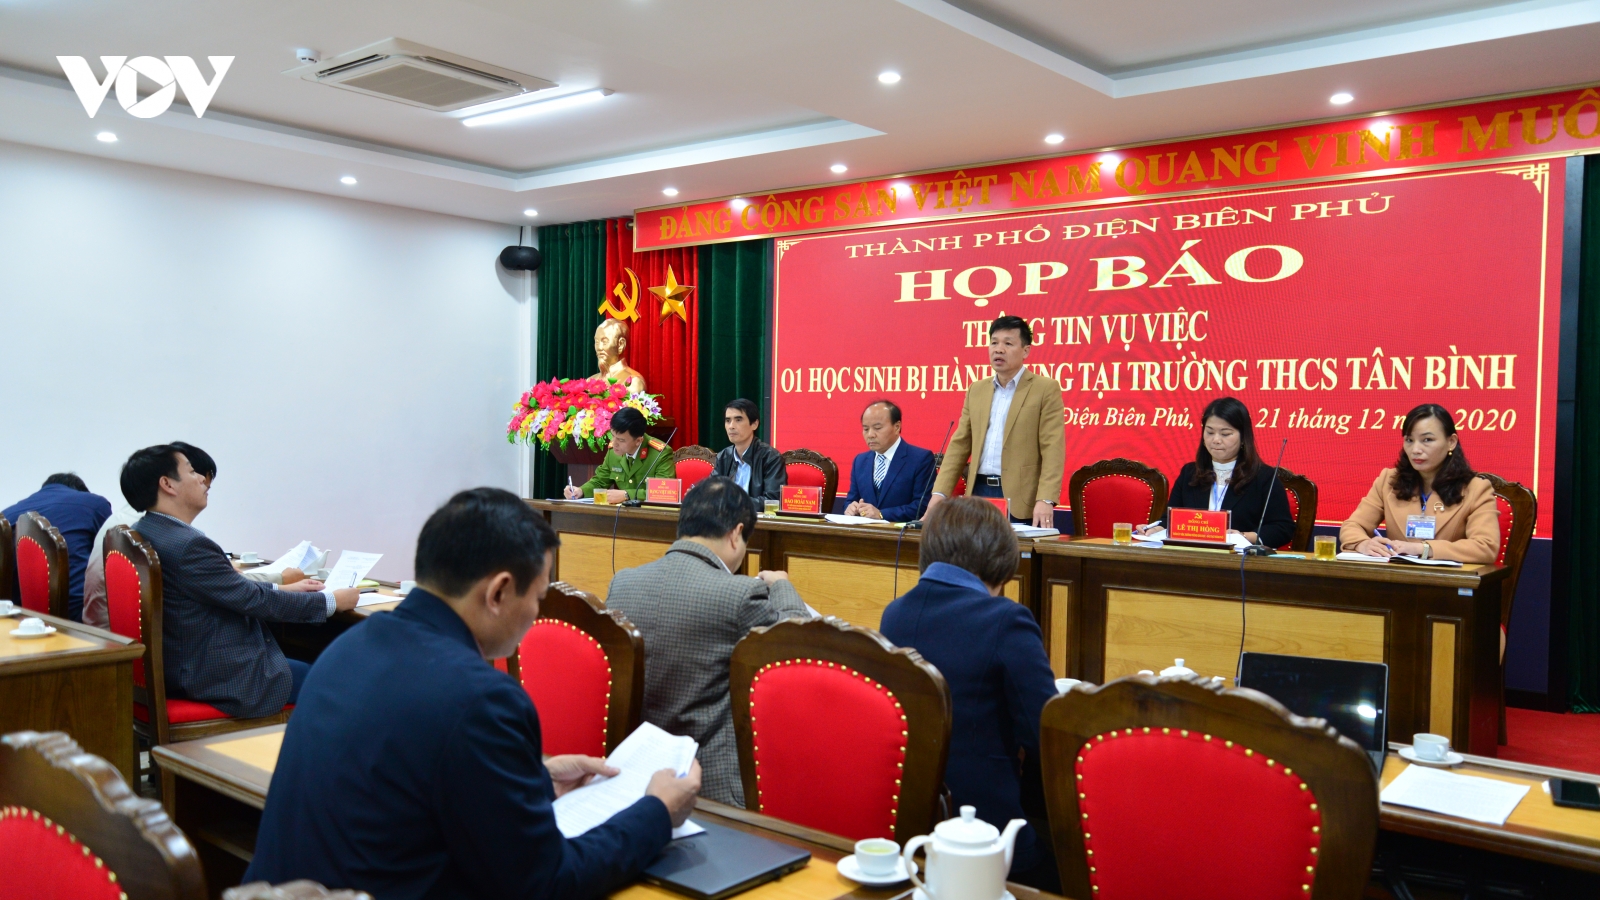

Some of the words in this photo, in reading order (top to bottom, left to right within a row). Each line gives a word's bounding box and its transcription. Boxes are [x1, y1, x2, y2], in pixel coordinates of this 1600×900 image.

[659, 205, 733, 240] ĐẢNG
[741, 194, 824, 231] CỘNG
[834, 181, 898, 220] SẢN
[914, 170, 998, 213] VIỆT
[1009, 160, 1103, 201] NAM
[1115, 140, 1280, 195] QUANG
[1294, 120, 1439, 170] VINH
[844, 235, 963, 259] THÀNH
[972, 223, 1051, 248] PHỐ
[1062, 217, 1158, 240] ĐIỆN
[1172, 206, 1277, 231] BIÊN
[1290, 192, 1396, 221] PHỦ
[894, 261, 1069, 307] HỌP
[1089, 239, 1304, 292] BÁO
[962, 311, 1046, 348] THG
[1051, 316, 1093, 345] TIN
[1100, 314, 1139, 351] VỤ
[1142, 306, 1209, 350] VIỆC
[808, 366, 851, 399] HỌC
[853, 366, 902, 392] SINH
[906, 366, 929, 399] BỊ
[1078, 362, 1123, 399] TẠI
[1127, 352, 1249, 391] TRƯỜNG
[1257, 357, 1338, 391] THCS
[1346, 347, 1415, 390] TÂN
[1423, 345, 1517, 390] BÌNH
[1064, 407, 1100, 429] Điện
[1103, 407, 1146, 427] Biên
[1150, 407, 1194, 430] Phủ,
[1255, 408, 1279, 428] 21
[1288, 408, 1352, 434] tháng
[1357, 408, 1386, 429] 12
[1454, 408, 1517, 431] 2020
